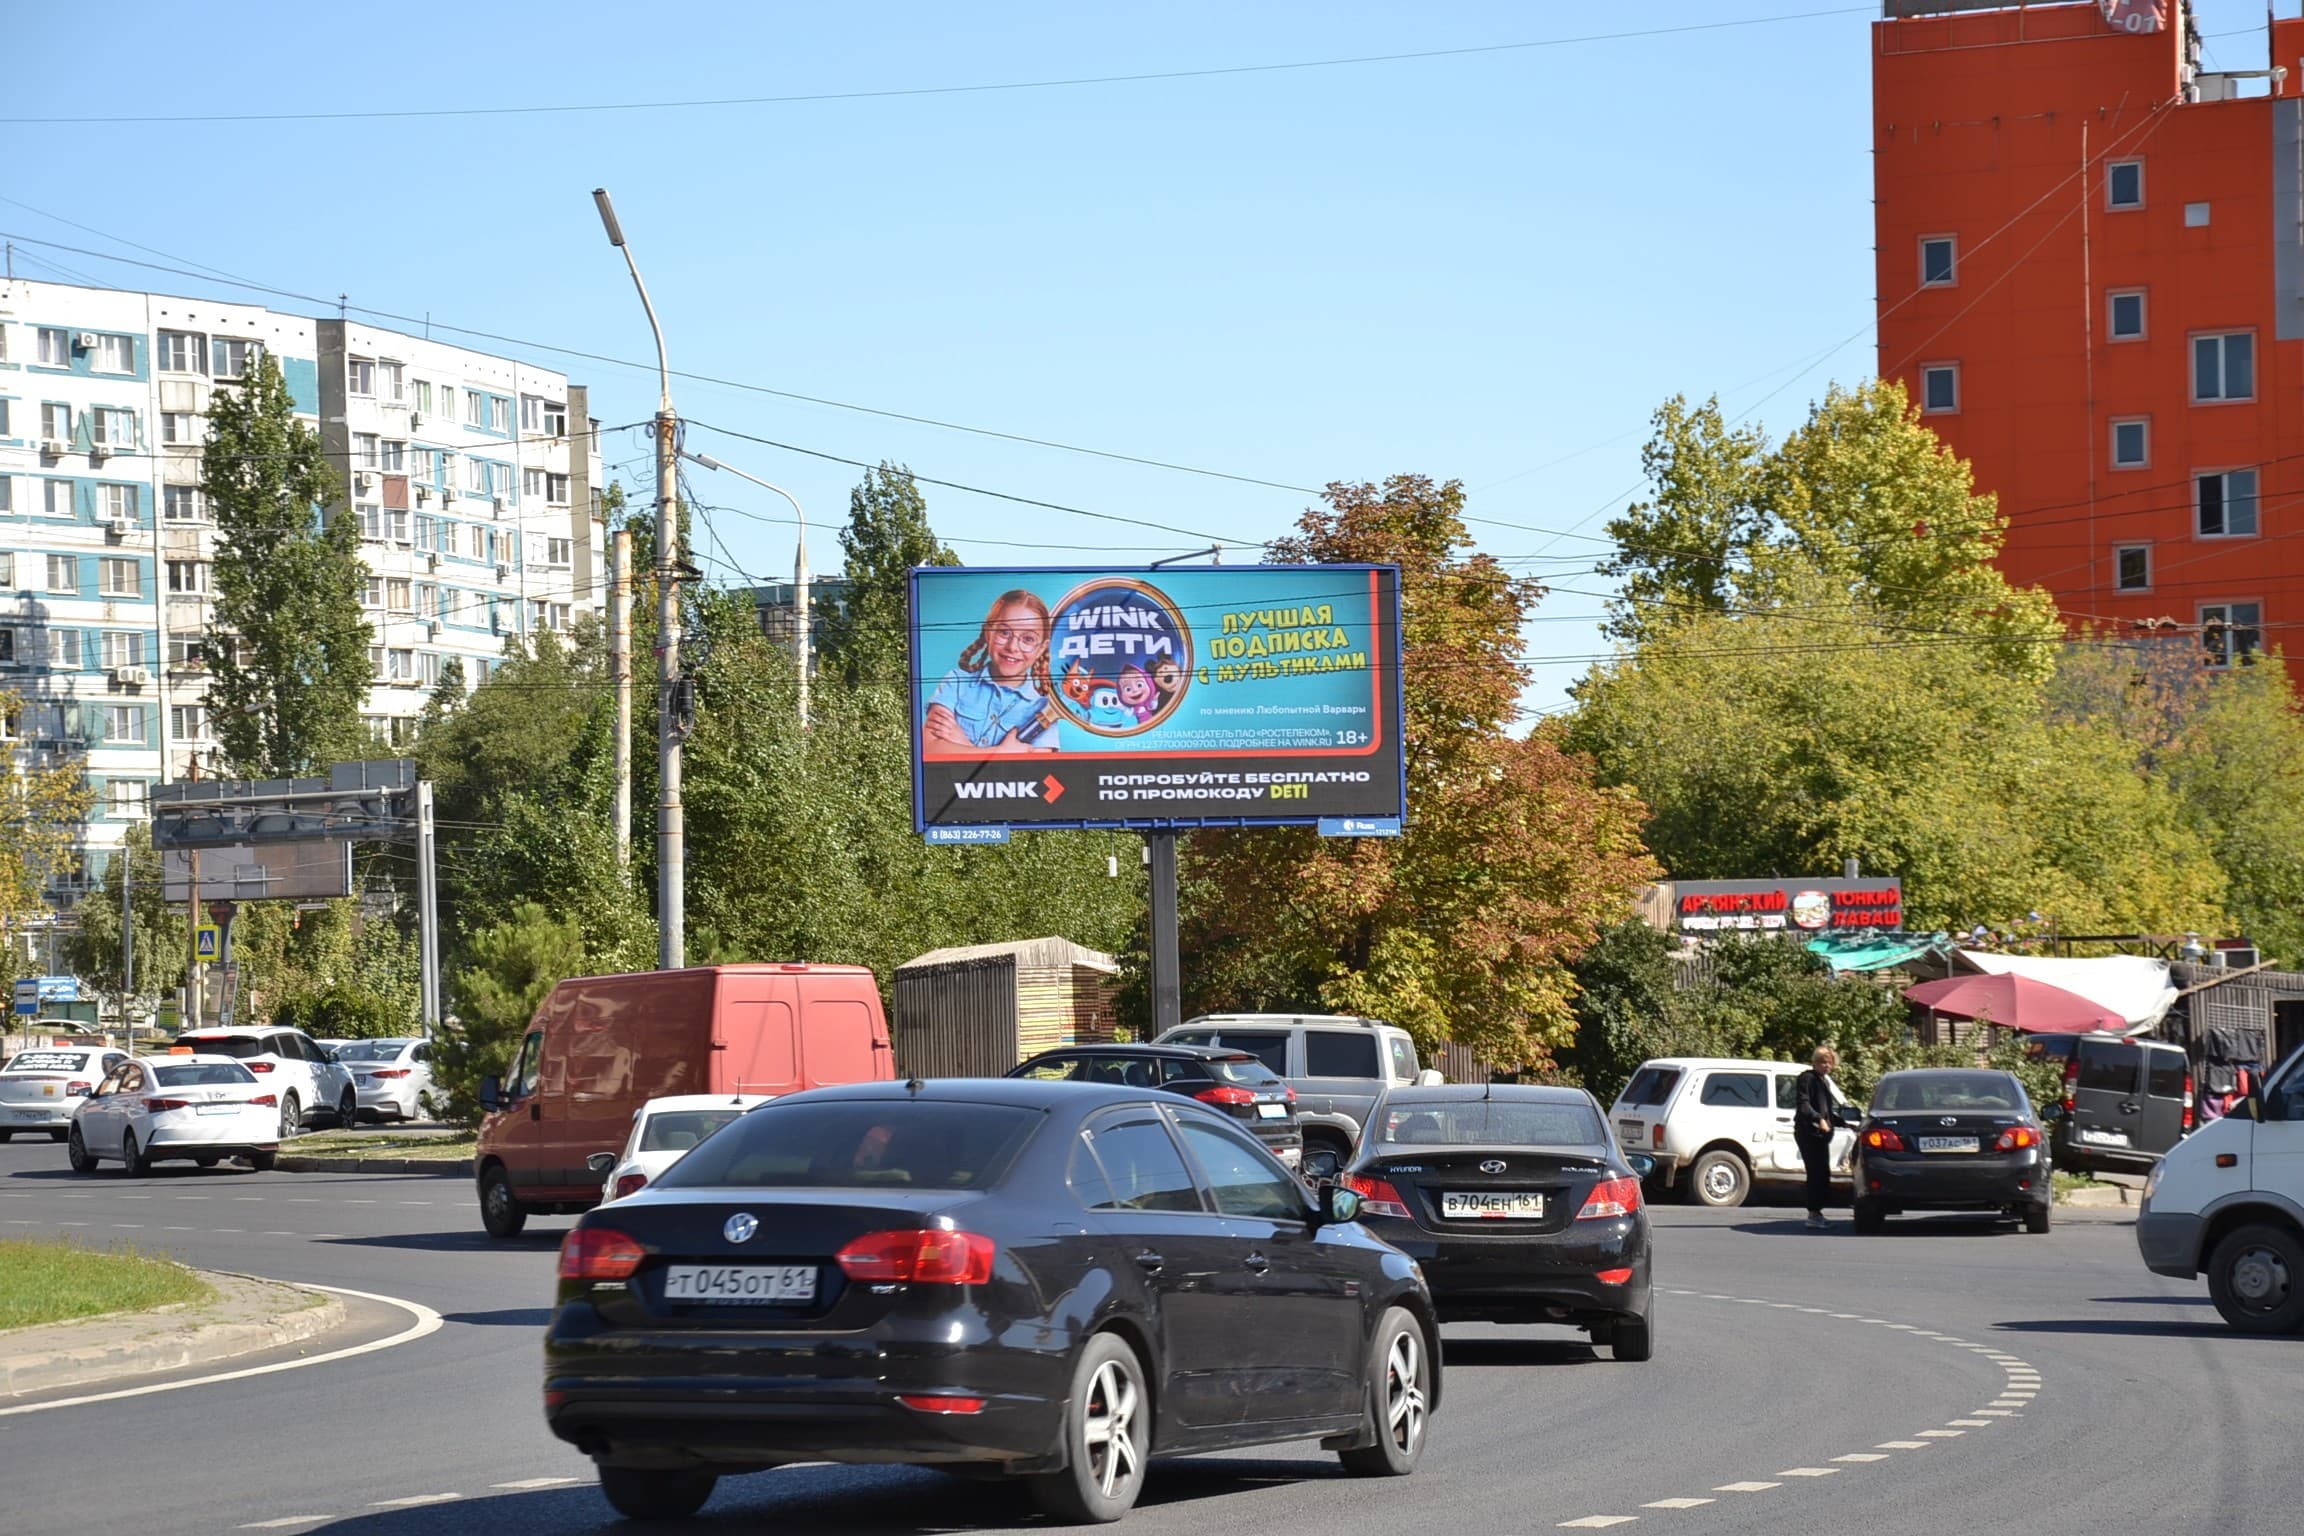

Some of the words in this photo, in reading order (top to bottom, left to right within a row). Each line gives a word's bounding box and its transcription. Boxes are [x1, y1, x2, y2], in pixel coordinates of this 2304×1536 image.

[1068, 605, 1165, 631] WINK
[1222, 604, 1333, 635] ЛУЧШАЯ
[1058, 633, 1172, 659] ДЕТИ
[1209, 628, 1349, 659] ПОДПИСКА
[1217, 652, 1366, 683] МУЛЬТИКАМИ
[1215, 707, 1254, 715] мнению
[1256, 705, 1321, 715] Любопытной
[1323, 705, 1366, 715] Варвары
[1235, 729, 1256, 738] ПАО
[1336, 730, 1368, 745] 18+
[1219, 738, 1278, 749] ПОДРОБНЕЕ
[1278, 738, 1292, 747] НА
[1099, 772, 1241, 786] ПОПРОБУЙТЕ
[1245, 771, 1370, 784] БЕСПЛАТНО
[954, 781, 1039, 799] WINK
[1099, 789, 1128, 801] ПО
[1133, 787, 1264, 800] ПРОМОКОДУ
[1270, 784, 1309, 799] DETI
[932, 830, 938, 839] 8
[940, 830, 960, 840] (863)
[962, 829, 1002, 839] 226-77-26
[1832, 886, 1900, 905] ТОНКИЙ
[1833, 910, 1901, 927] ЛАВАШ
[1448, 1194, 1511, 1211] В704ЕН
[1515, 1194, 1539, 1207] 161
[679, 1268, 775, 1295] Т045ОТ
[781, 1268, 808, 1287] 61
